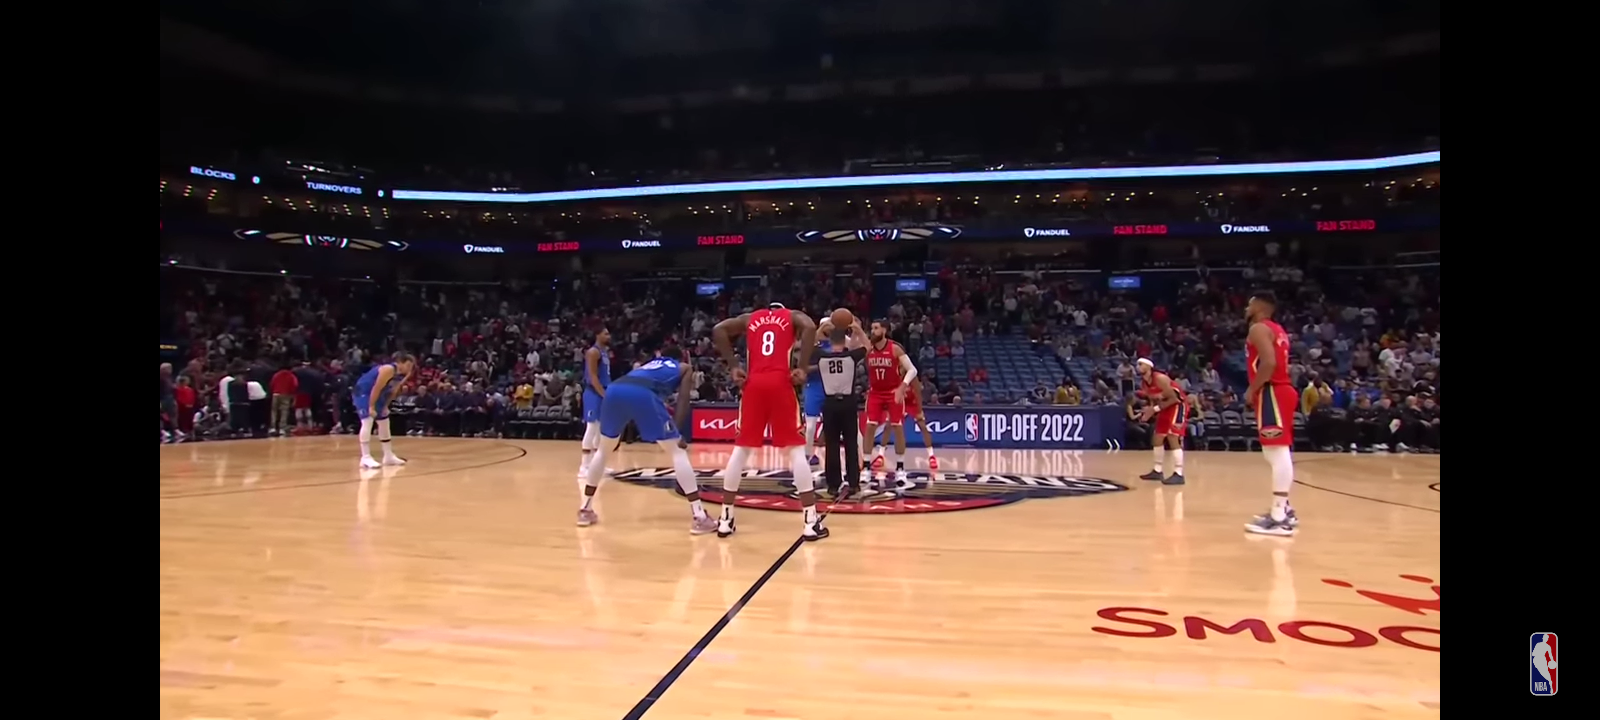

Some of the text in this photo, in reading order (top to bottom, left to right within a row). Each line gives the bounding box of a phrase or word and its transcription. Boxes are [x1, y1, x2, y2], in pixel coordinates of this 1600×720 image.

[190, 166, 260, 184] BLOCKS 0
[306, 181, 384, 198] TURNOVERS 0
[1113, 224, 1168, 234] FAN STAND
[1233, 224, 1270, 233] FANDUEL
[1317, 219, 1375, 231] FAN STAND
[1035, 228, 1070, 236] FANDUEL
[631, 240, 661, 248] FANDUEL
[697, 234, 744, 245] FAN STAND
[473, 245, 504, 253] FANDUEL
[537, 241, 579, 251] FAN STAND
[748, 315, 790, 332] MARSHALL
[761, 330, 775, 356] 8
[829, 360, 843, 374] 26
[868, 357, 893, 368] PELICANS
[875, 368, 886, 380] 17
[1040, 413, 1084, 441] 2022
